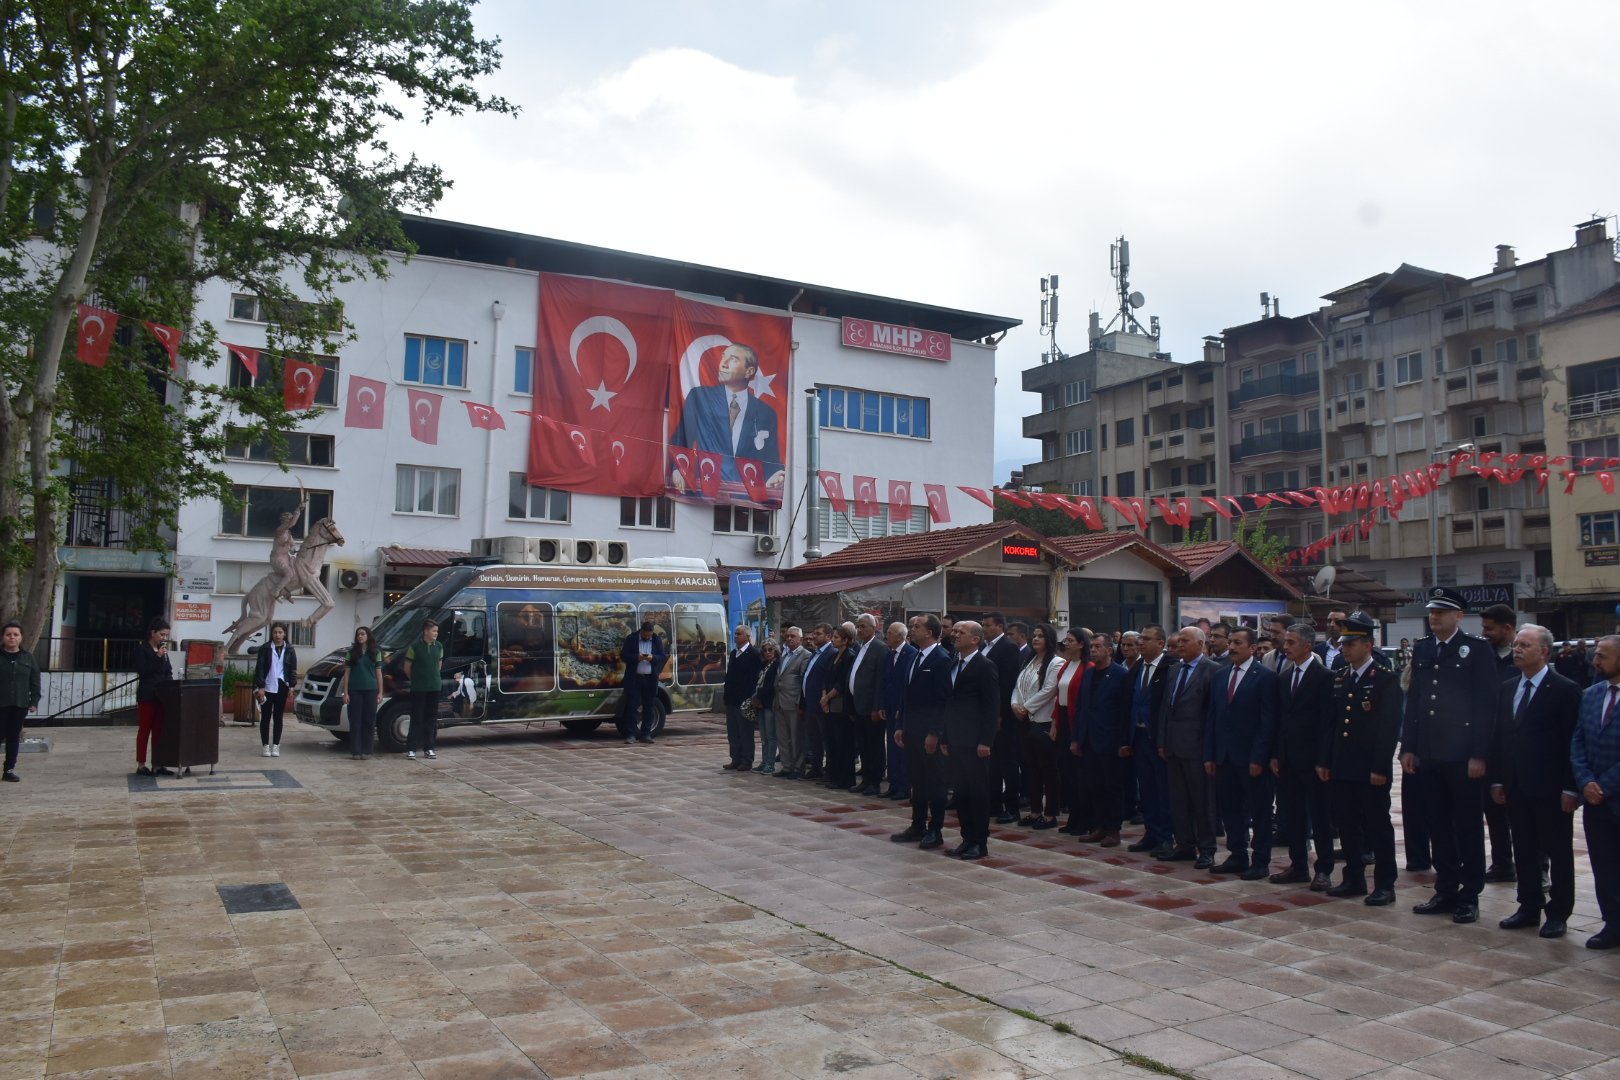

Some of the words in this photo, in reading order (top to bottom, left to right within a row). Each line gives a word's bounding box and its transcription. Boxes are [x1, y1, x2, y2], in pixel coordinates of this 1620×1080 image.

[873, 324, 923, 348] MHP
[674, 577, 717, 586] KARACASU
[1460, 587, 1510, 603] OBİLYA
